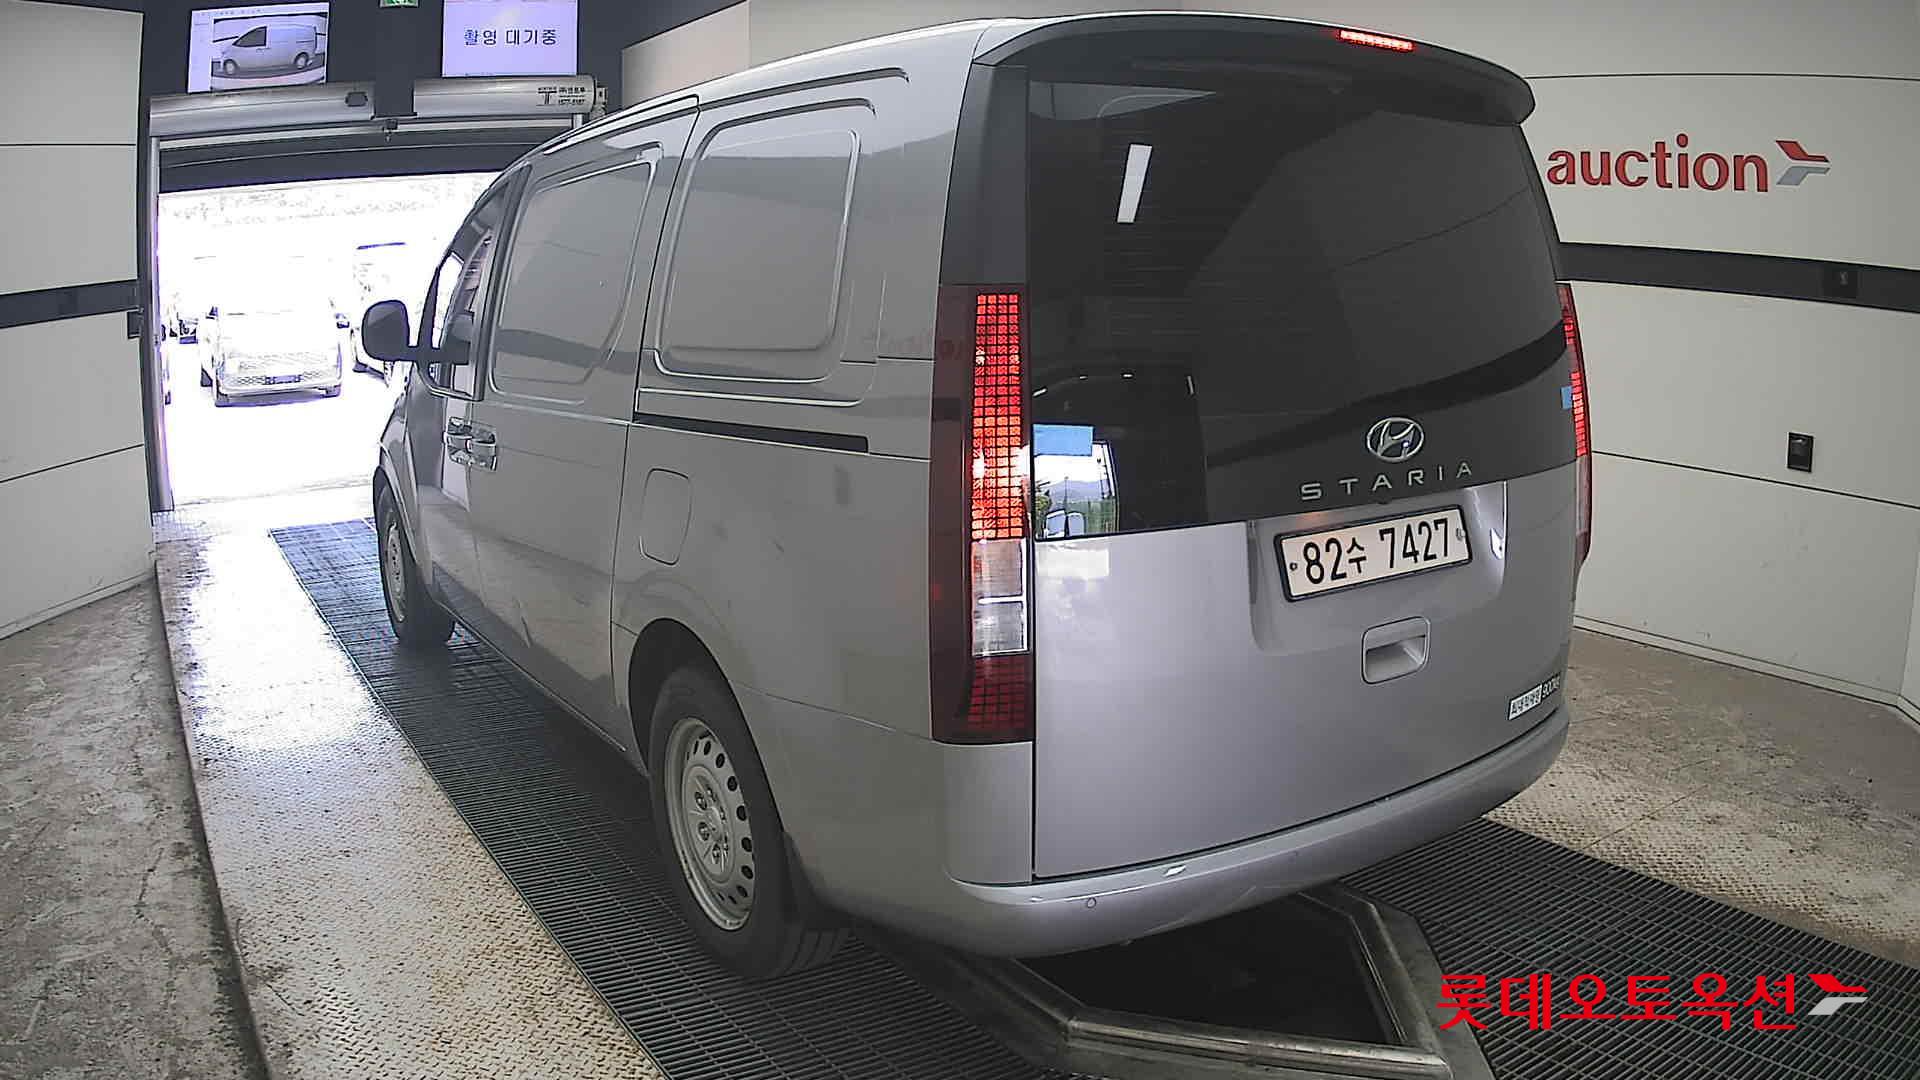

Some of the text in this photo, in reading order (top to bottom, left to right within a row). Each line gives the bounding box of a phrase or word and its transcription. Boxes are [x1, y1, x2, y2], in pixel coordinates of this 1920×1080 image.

[505, 28, 557, 46] 대기중
[1547, 133, 1768, 192] auction
[1300, 462, 1473, 501] STARIA
[1303, 517, 1449, 584] 82수 7427
